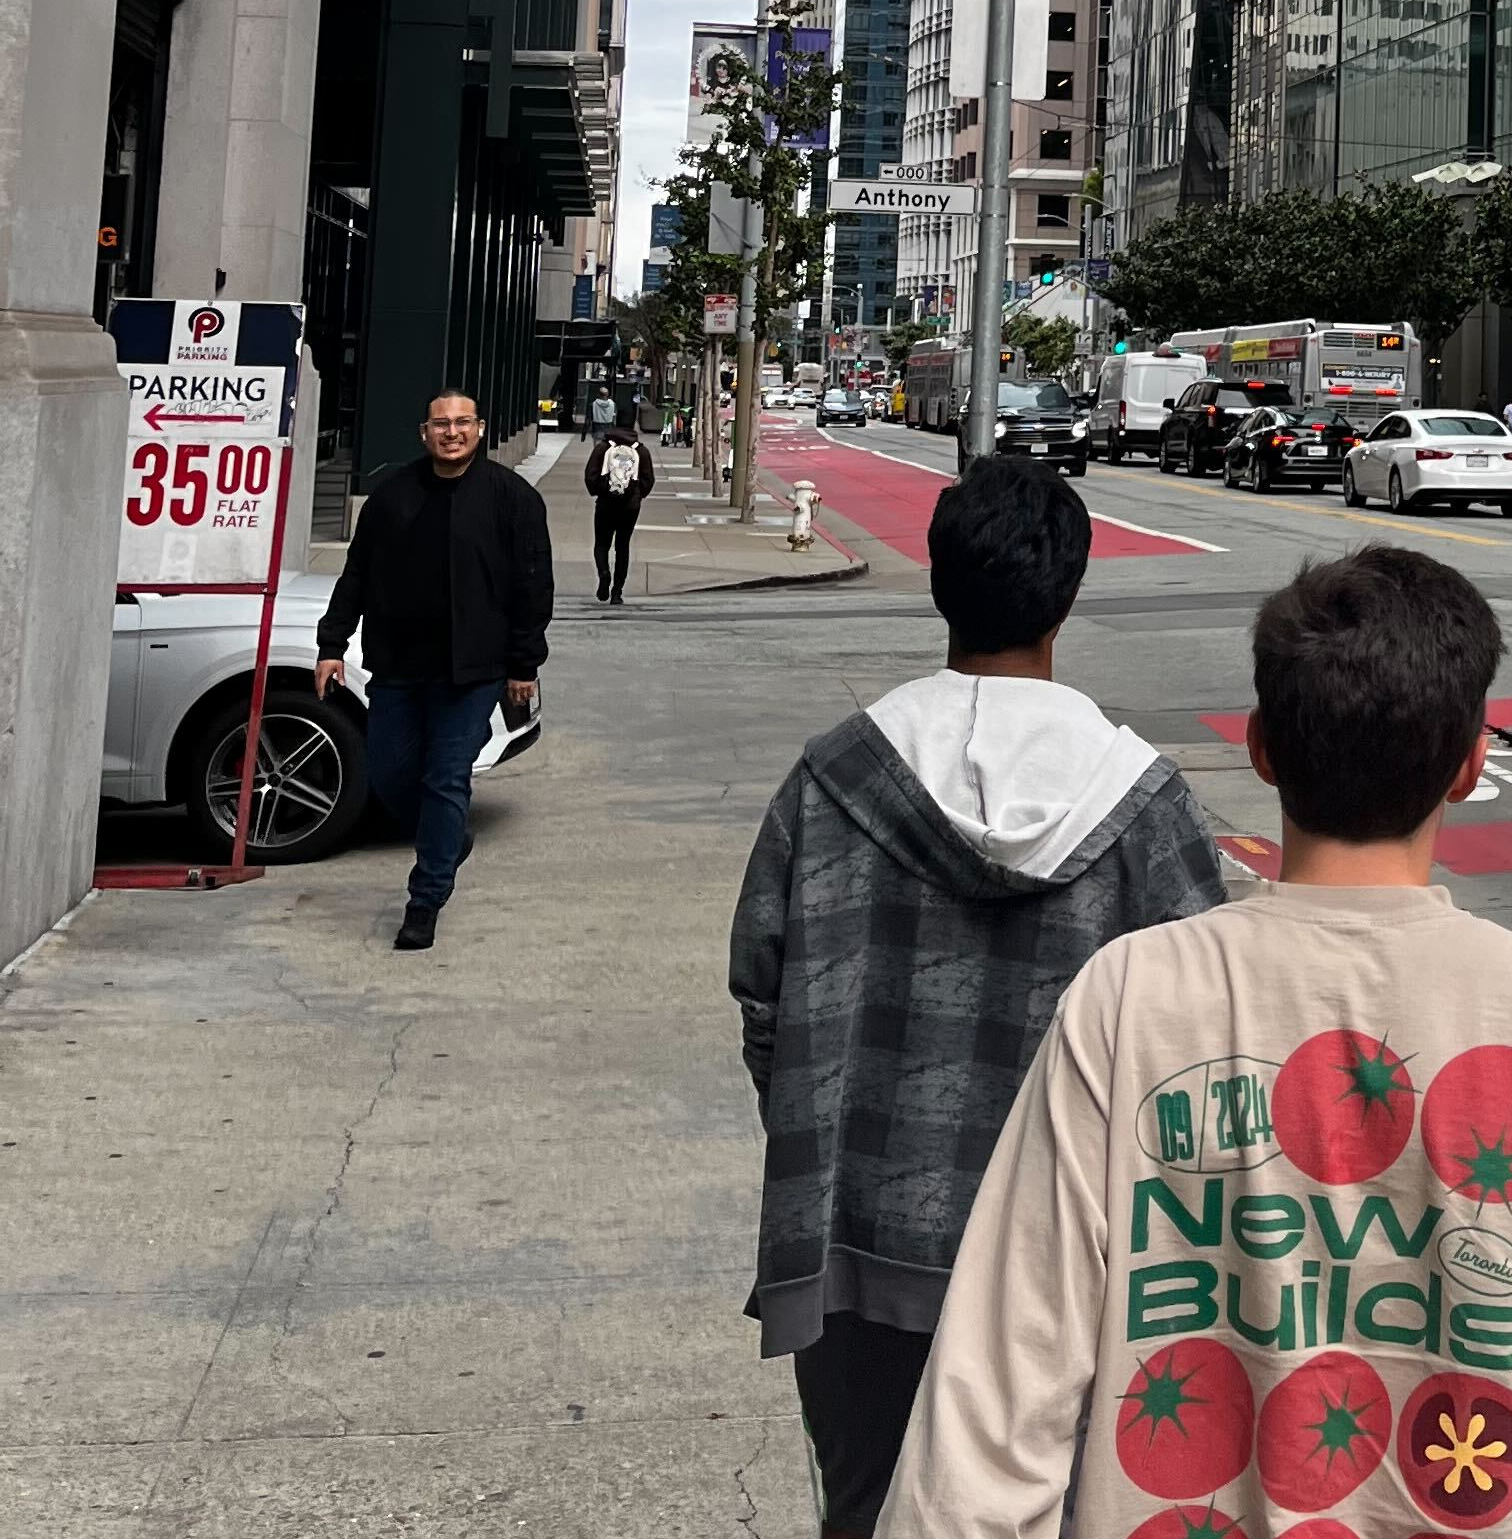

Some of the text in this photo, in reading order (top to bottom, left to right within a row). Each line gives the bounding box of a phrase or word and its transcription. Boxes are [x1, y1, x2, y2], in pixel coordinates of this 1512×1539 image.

[896, 167, 925, 179] 000
[854, 187, 951, 212] Anthony
[177, 353, 228, 361] PARKING
[129, 374, 266, 401] PARKING
[217, 500, 261, 512] FLAT
[212, 515, 259, 528] RATE
[1130, 1177, 1446, 1260] New
